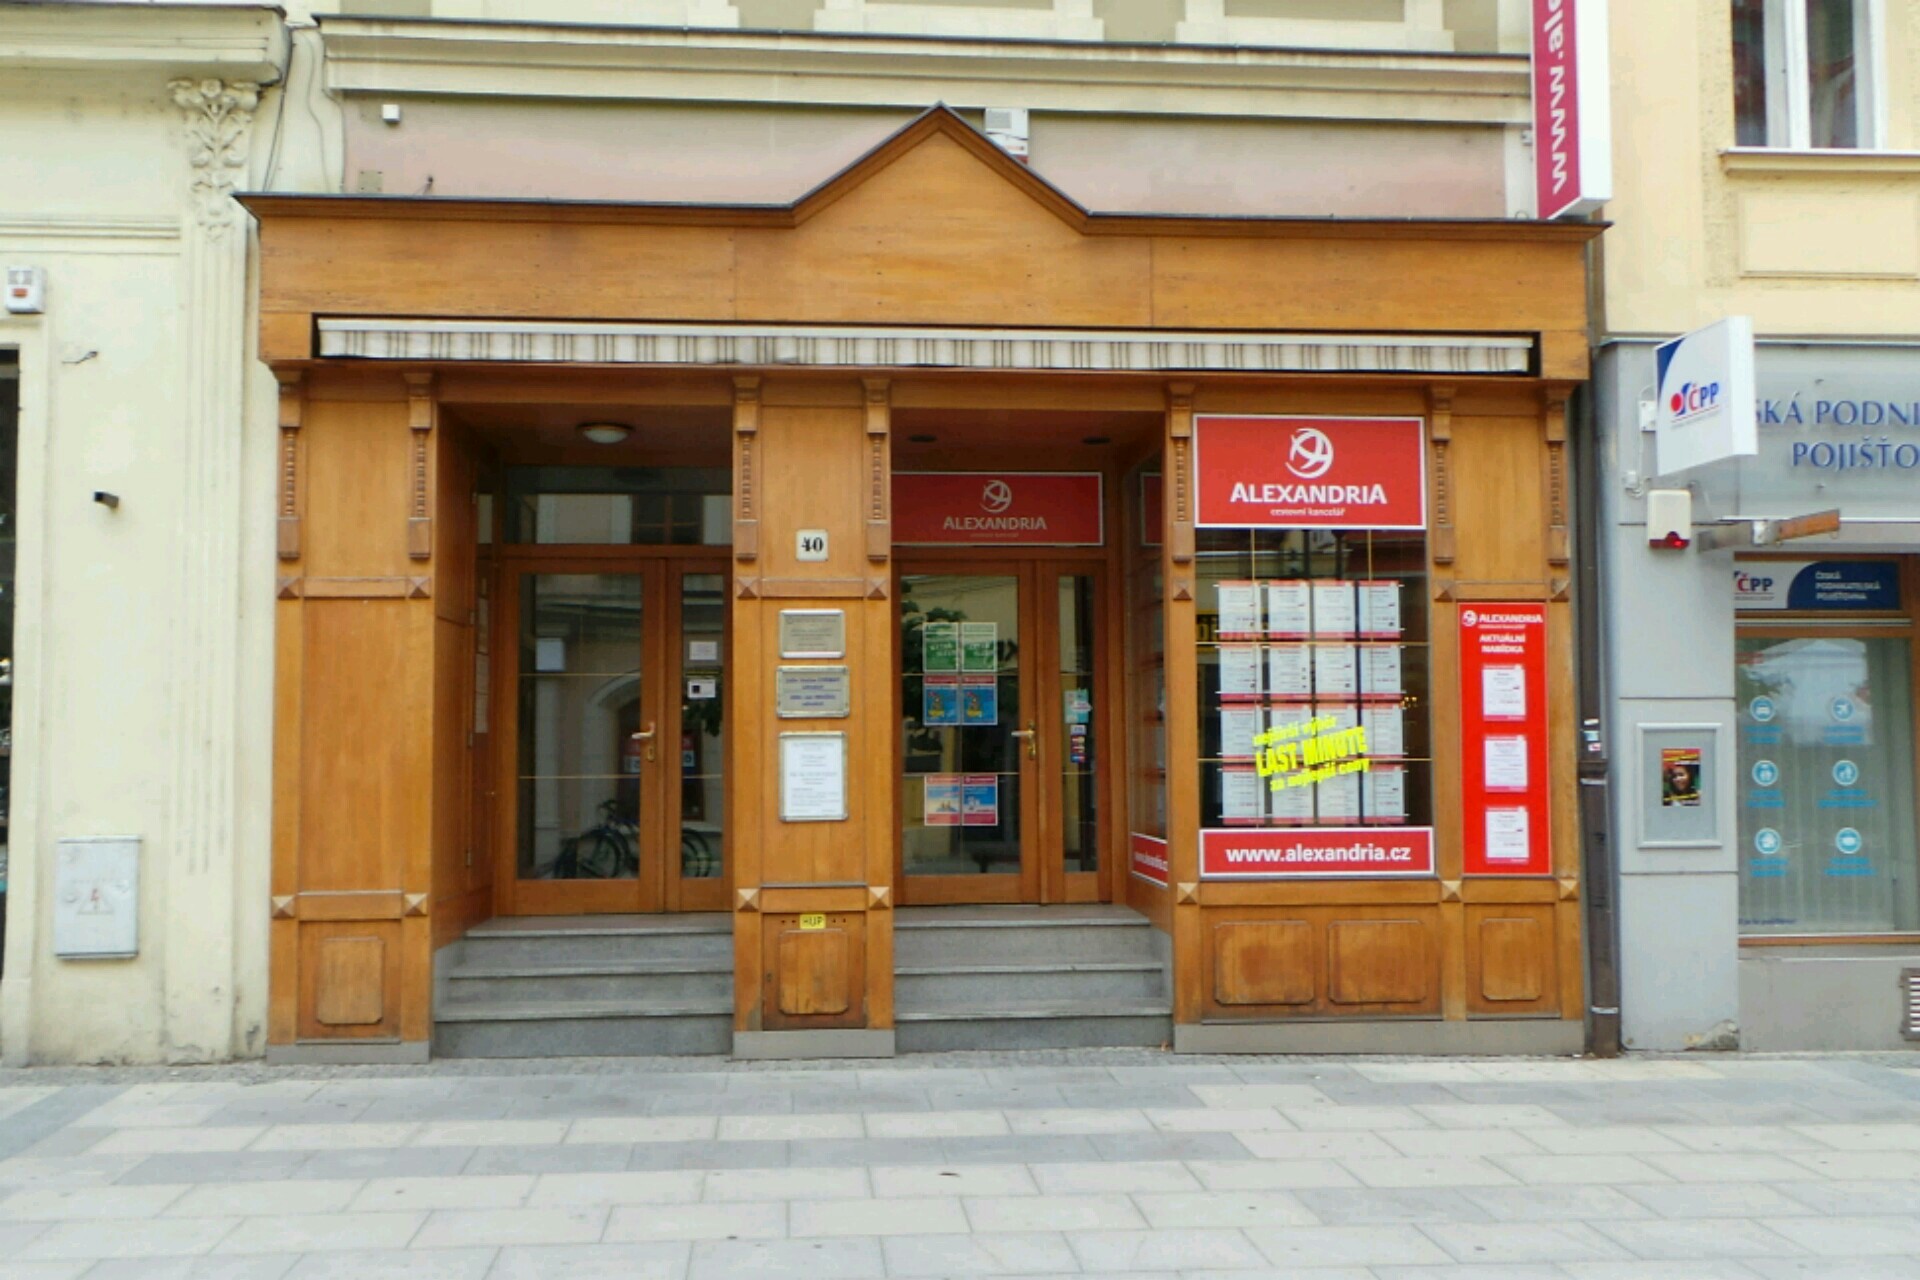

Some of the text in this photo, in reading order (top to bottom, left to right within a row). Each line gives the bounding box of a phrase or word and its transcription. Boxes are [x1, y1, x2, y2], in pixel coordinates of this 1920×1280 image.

[1688, 382, 1720, 411] ČPP
[1815, 399, 1919, 426] PODNI
[1230, 482, 1387, 504] ALEXANDRIA
[943, 516, 1048, 530] ALEXANDRIA
[801, 537, 824, 552] 40
[1738, 573, 1773, 592] ČPP
[1479, 613, 1543, 624] ALEXANDRIA
[1479, 632, 1526, 643] AKTUÁLNÍ
[1256, 742, 1298, 777] LAST
[1302, 726, 1368, 766] MINUTE
[1225, 843, 1412, 862] www.alexandria.cz
